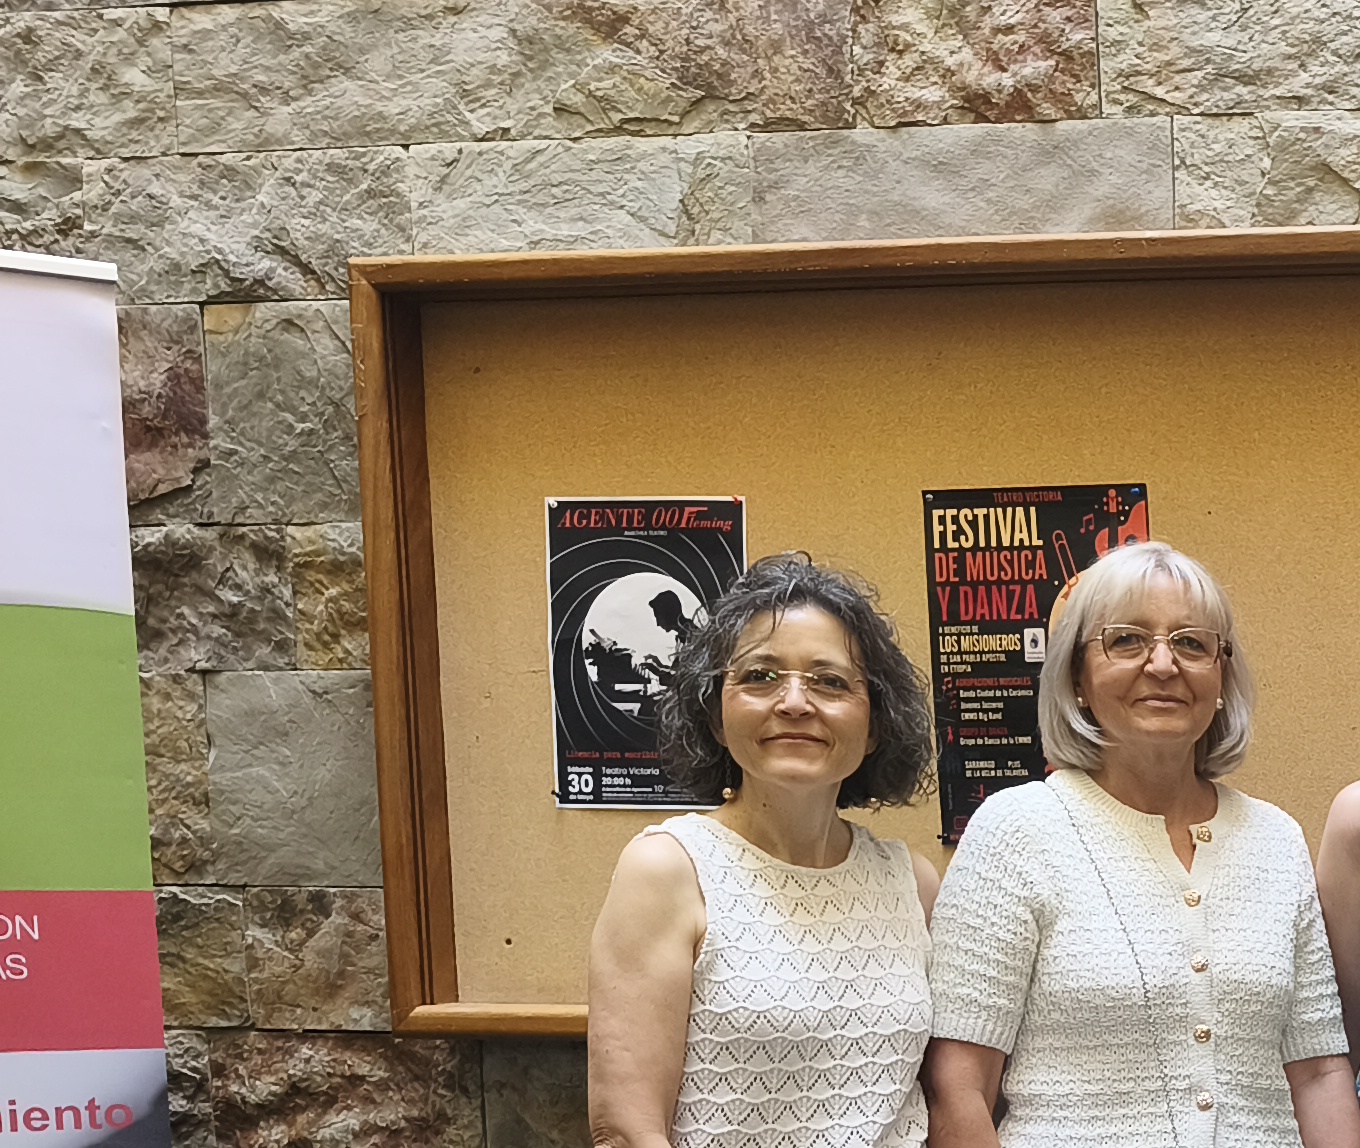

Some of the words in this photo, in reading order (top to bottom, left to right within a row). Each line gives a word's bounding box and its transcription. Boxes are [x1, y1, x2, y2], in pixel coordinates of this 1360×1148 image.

[993, 492, 1023, 503] TEATRO
[1025, 491, 1063, 502] VICTORIA
[557, 508, 647, 529] AGENTE
[932, 506, 1044, 549] FESTIVAL
[934, 552, 960, 582] DE
[965, 547, 1048, 582] MÚSICA
[936, 586, 951, 622] Y
[958, 583, 1039, 622] DANZA
[939, 635, 958, 653] LOS
[960, 633, 1021, 652] MISIONEROS
[602, 767, 627, 775] Teatro
[629, 767, 660, 775] Victoria
[567, 774, 594, 793] 30
[0, 1097, 133, 1133] iento
